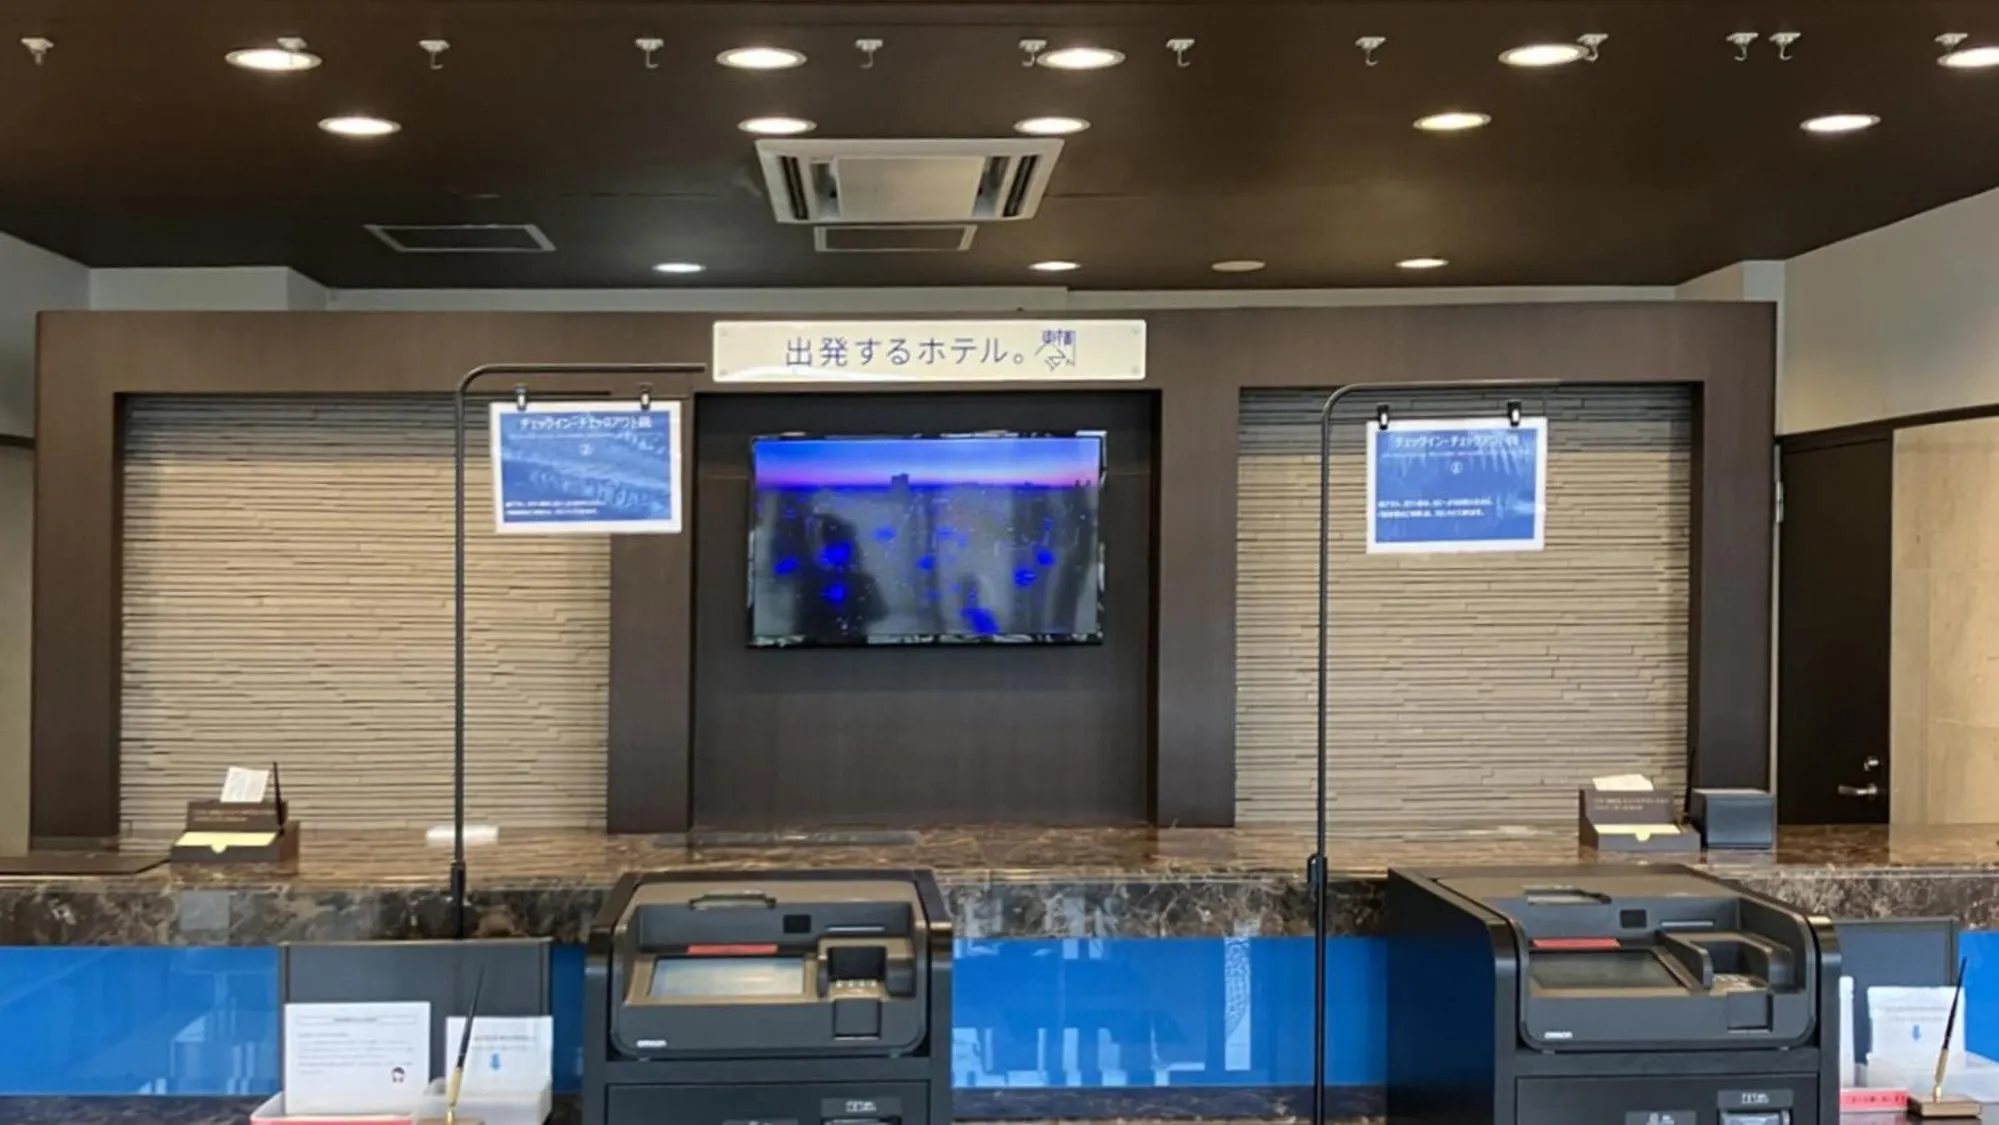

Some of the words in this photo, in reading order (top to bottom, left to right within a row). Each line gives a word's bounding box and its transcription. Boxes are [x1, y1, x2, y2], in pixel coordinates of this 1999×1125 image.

[784, 336, 1024, 368] 出発するホテル。
